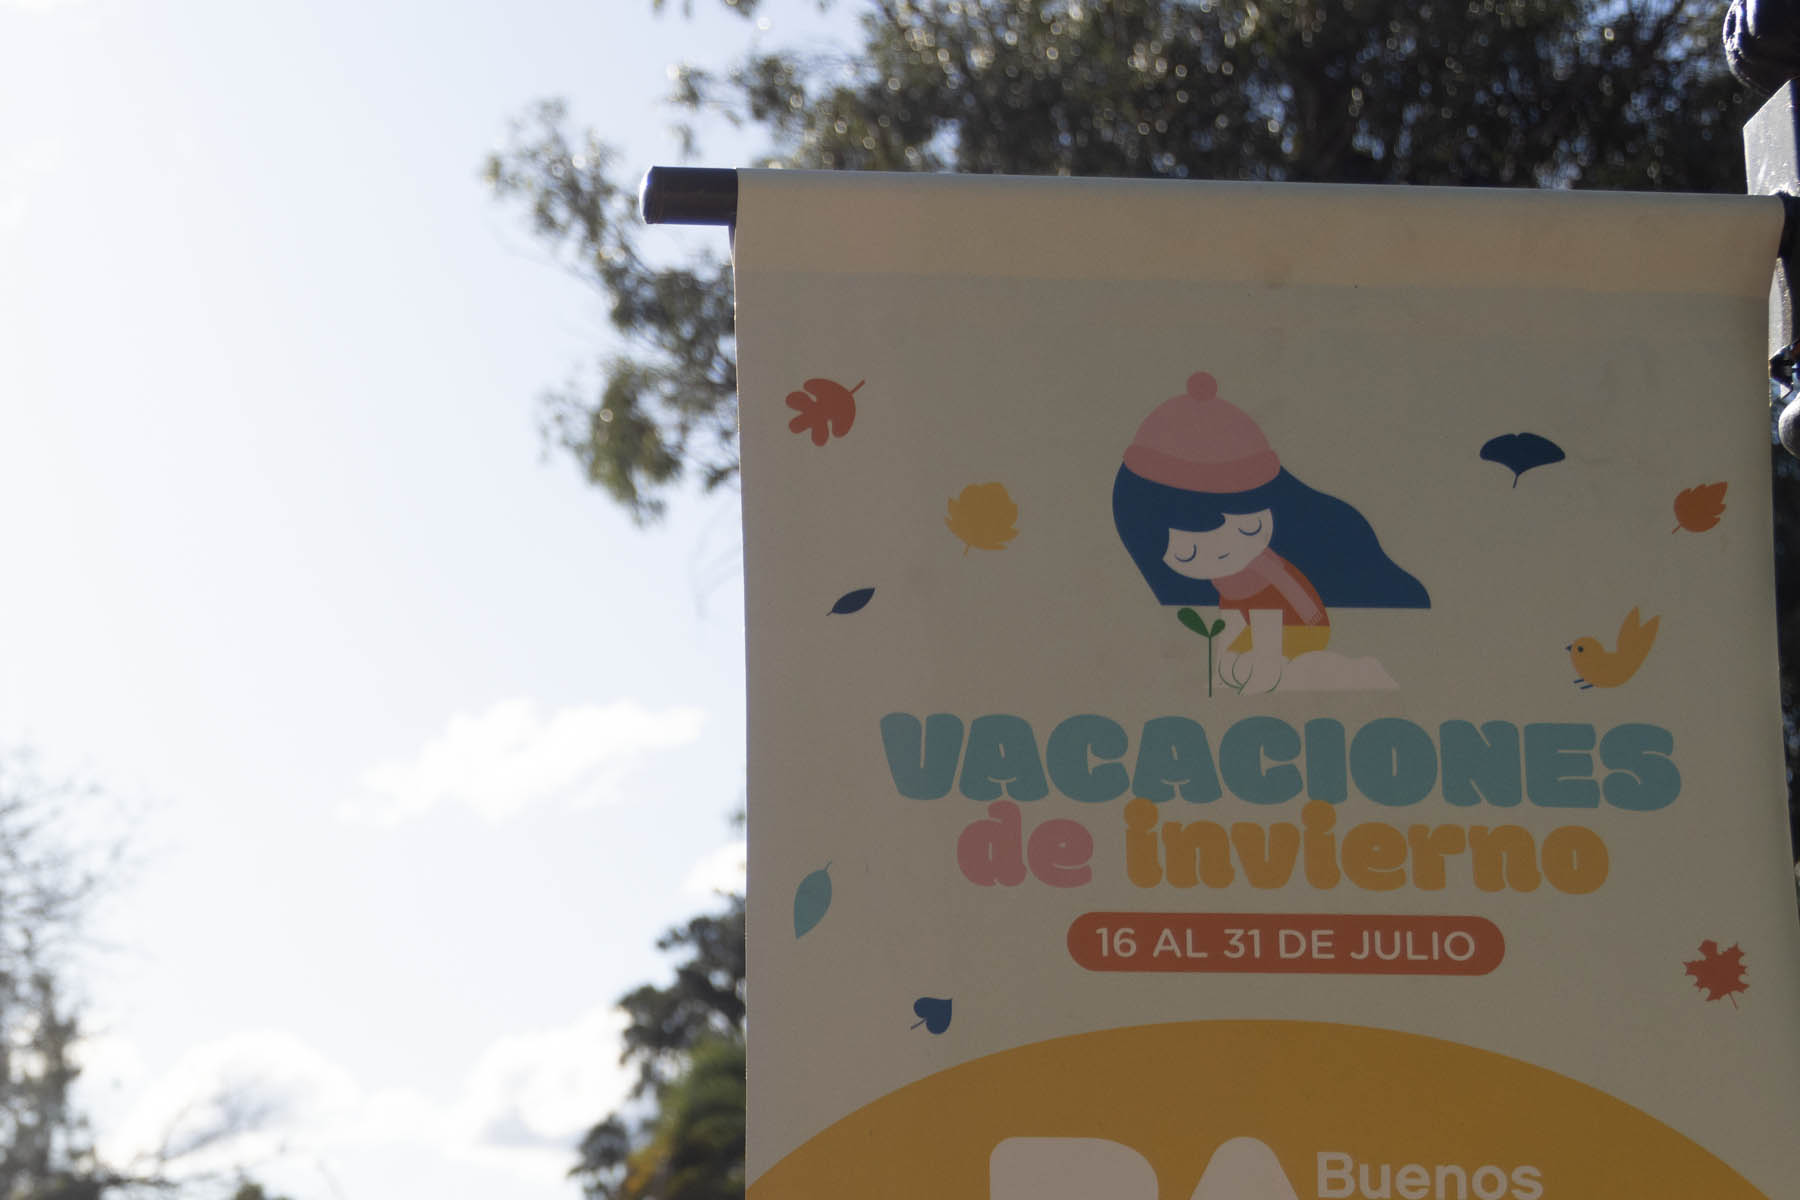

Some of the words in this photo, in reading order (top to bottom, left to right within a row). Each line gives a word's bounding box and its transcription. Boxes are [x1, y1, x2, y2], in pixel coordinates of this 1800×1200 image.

[879, 712, 1682, 812] VACACIONES
[957, 800, 1094, 888] de
[1123, 798, 1610, 896] invierno
[1095, 926, 1137, 960] 16
[1152, 927, 1209, 960] AL
[1222, 928, 1262, 960] 31
[1278, 929, 1337, 961] DE
[1349, 930, 1476, 963] JULIO
